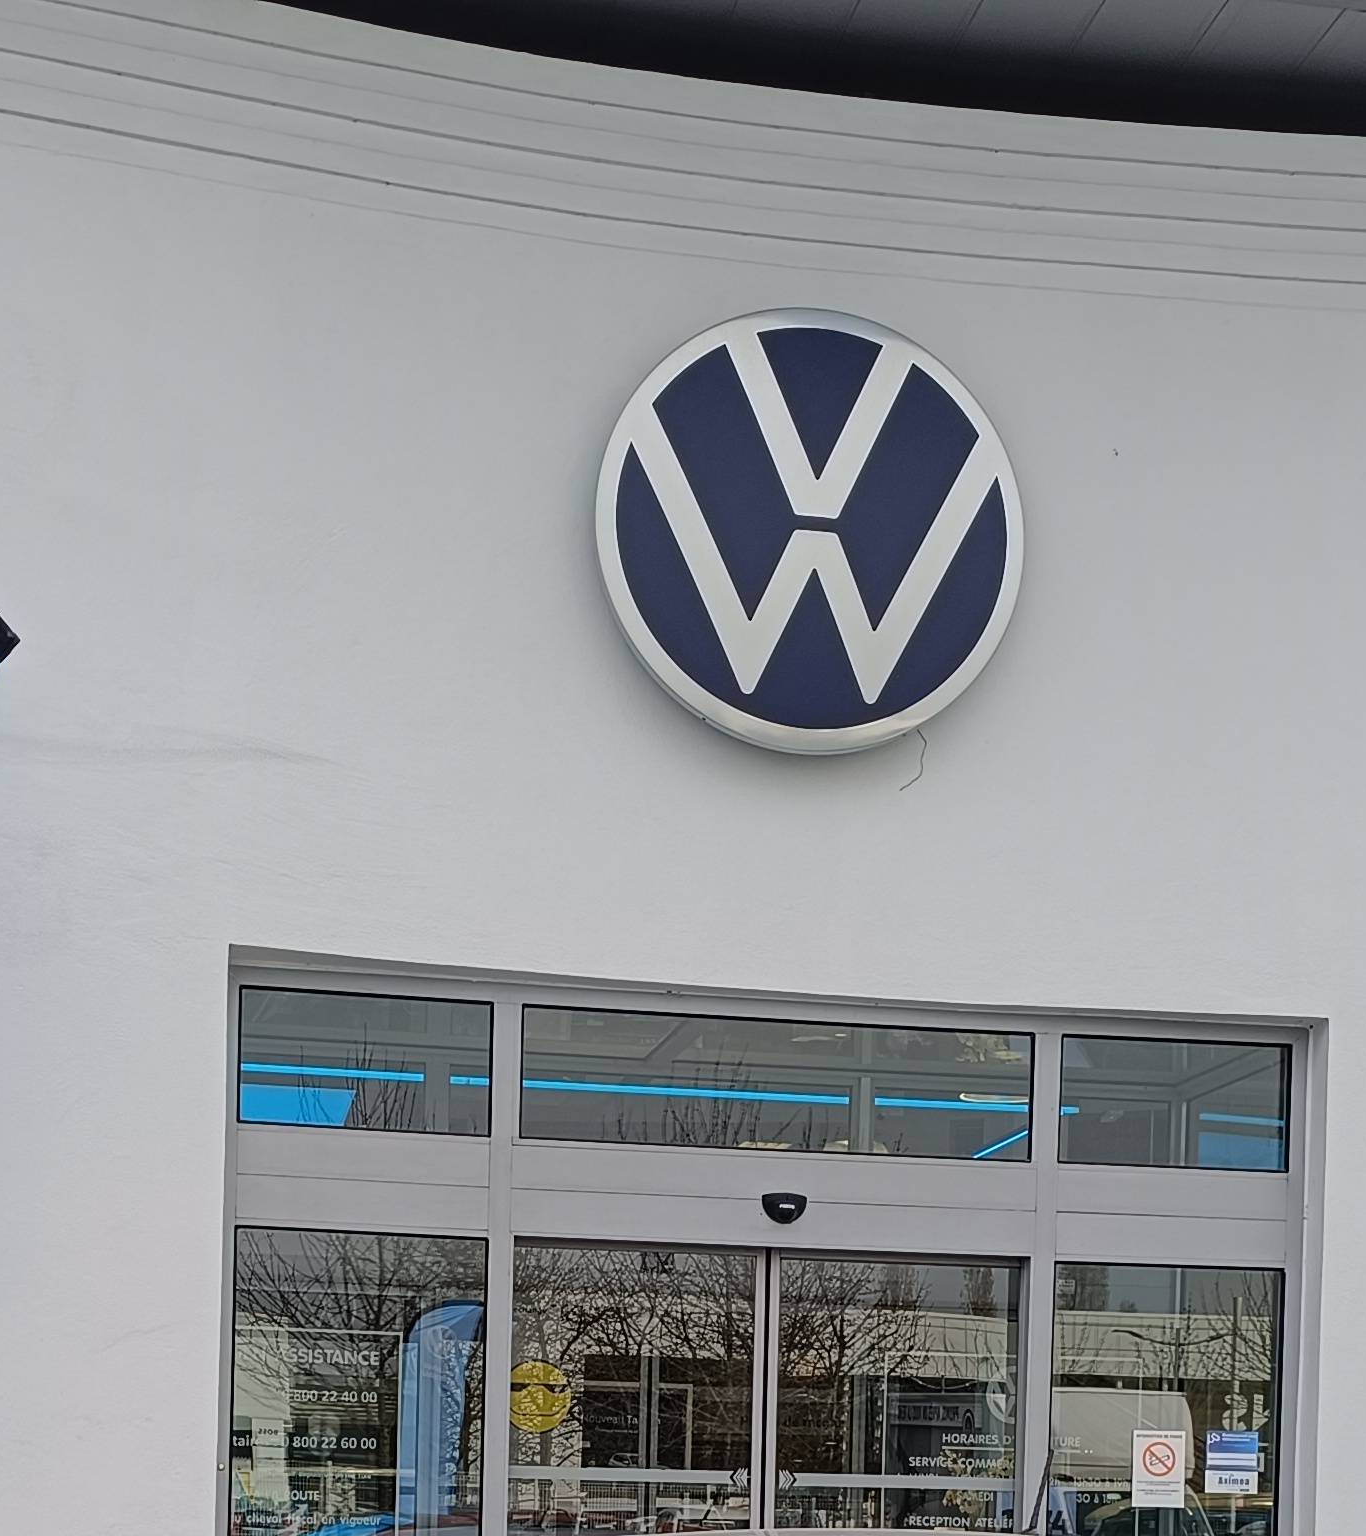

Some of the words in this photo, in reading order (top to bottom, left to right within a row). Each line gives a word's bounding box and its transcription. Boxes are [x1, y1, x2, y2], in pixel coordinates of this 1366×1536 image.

[360, 1391, 378, 1403] 00
[292, 1436, 318, 1448] 800
[321, 1437, 338, 1449] 22
[340, 1437, 358, 1449] 60
[360, 1438, 377, 1449] 00
[942, 1433, 999, 1446] HORAIRES
[908, 1456, 954, 1468] SERVICE
[339, 1514, 382, 1528] vigueur
[908, 1515, 970, 1528] RECEPTION
